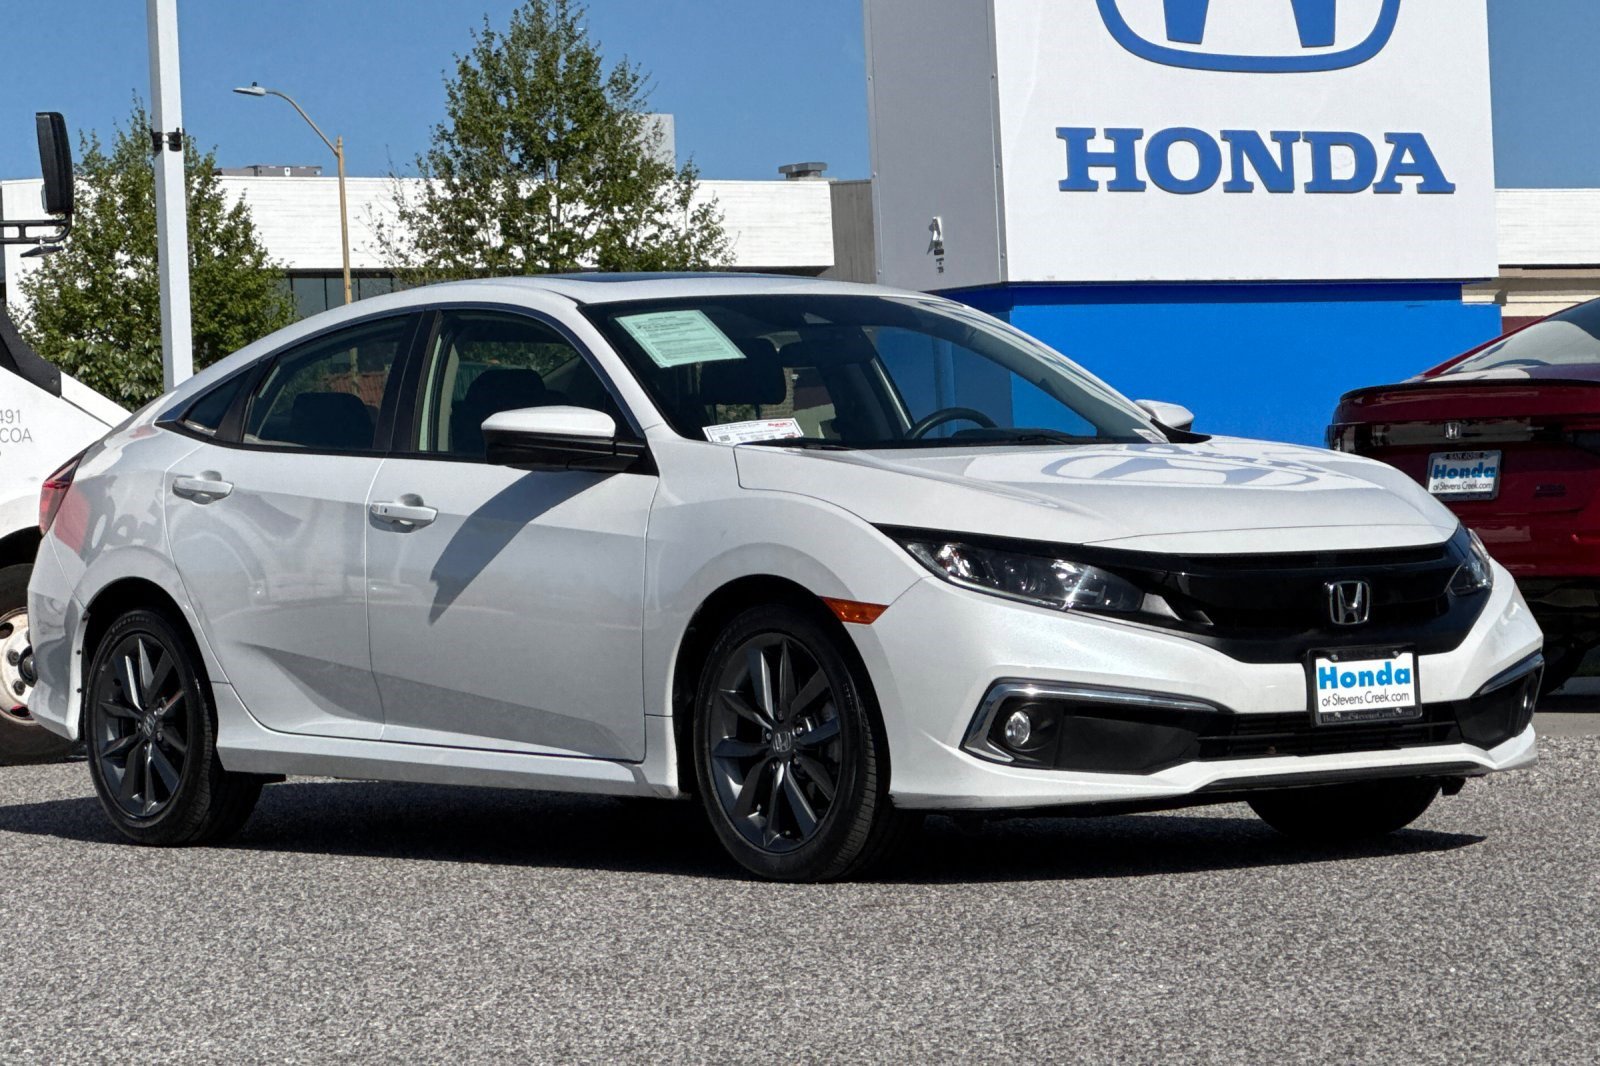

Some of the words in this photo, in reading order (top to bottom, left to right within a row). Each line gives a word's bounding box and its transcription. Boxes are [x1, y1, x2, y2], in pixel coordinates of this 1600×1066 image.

[1055, 126, 1456, 195] HONDA
[1433, 462, 1496, 480] Honda
[1439, 481, 1461, 491] Stevens
[1462, 480, 1493, 490] Creek.com
[1318, 661, 1411, 690] Honda
[1322, 696, 1331, 707] of
[1332, 693, 1363, 706] Stevens
[1364, 688, 1410, 704] Creek.com
